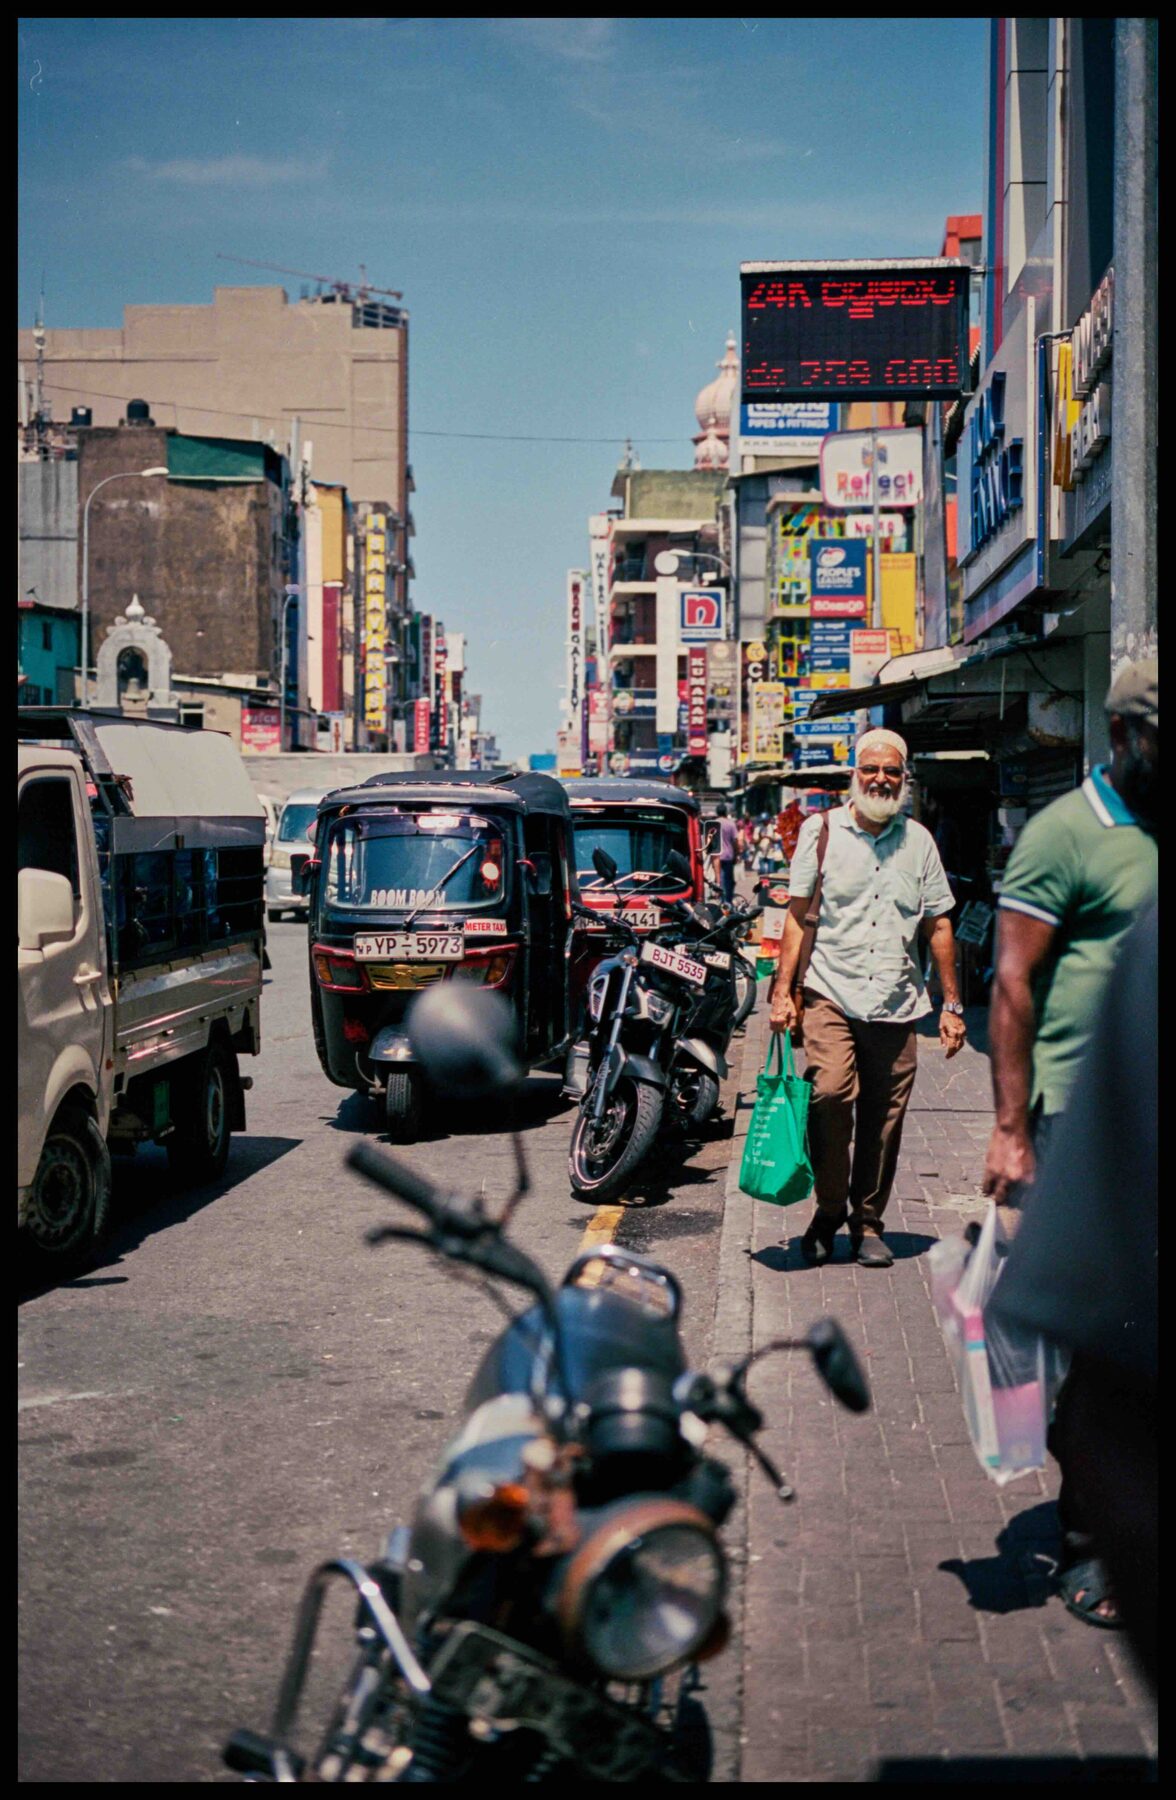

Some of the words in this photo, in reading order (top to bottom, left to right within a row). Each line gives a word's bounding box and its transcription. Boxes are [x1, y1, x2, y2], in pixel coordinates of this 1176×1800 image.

[691, 657, 705, 725] KUMARAN
[371, 889, 406, 906] BOOM
[409, 889, 446, 906] BOOM
[464, 922, 490, 930] METER
[653, 949, 675, 967] BJT
[676, 959, 704, 980] 5535
